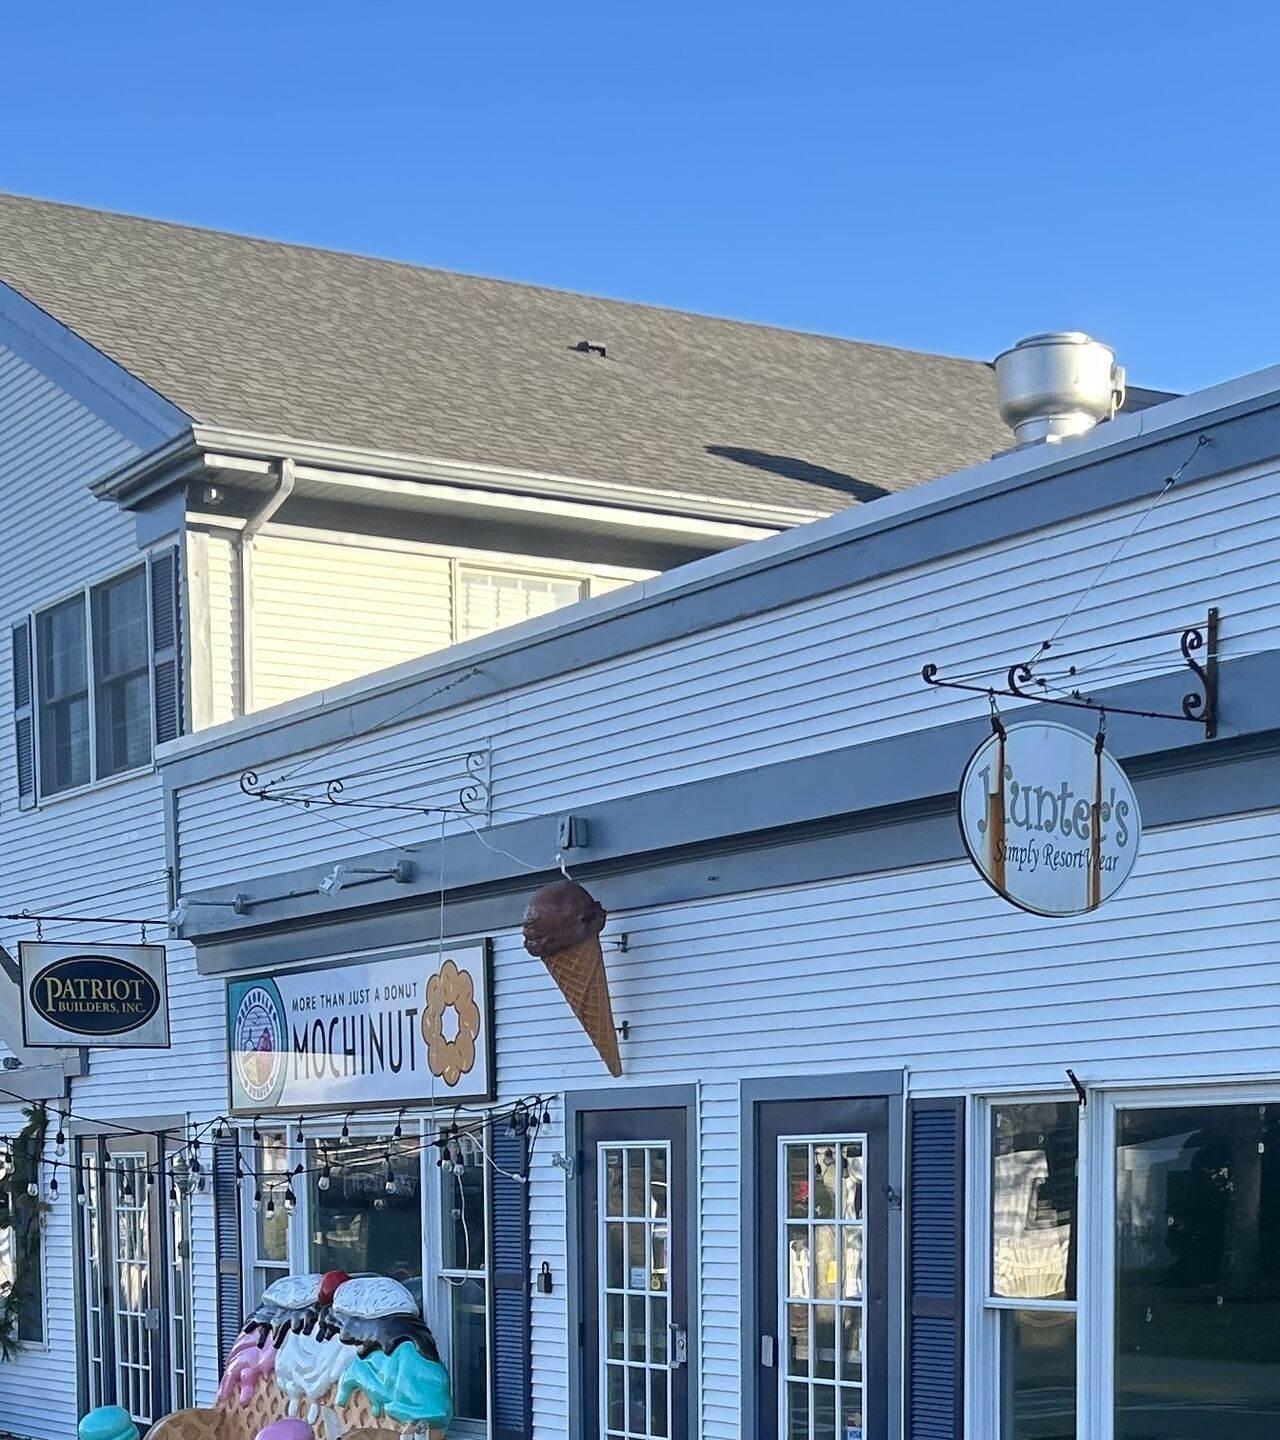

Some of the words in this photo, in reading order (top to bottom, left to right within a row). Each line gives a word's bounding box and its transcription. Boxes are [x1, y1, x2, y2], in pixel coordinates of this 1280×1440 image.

[993, 838, 1040, 873] Simply
[44, 976, 145, 1013] PATRIOT
[58, 1002, 120, 1014] BUILDERS,
[122, 1002, 146, 1013] INC.
[291, 997, 317, 1012] MORE
[321, 992, 345, 1009] THAN
[348, 989, 370, 1006] JUST
[374, 988, 381, 1002] A
[384, 982, 418, 1001] DONUT
[292, 1008, 418, 1081] MOCHINUT
